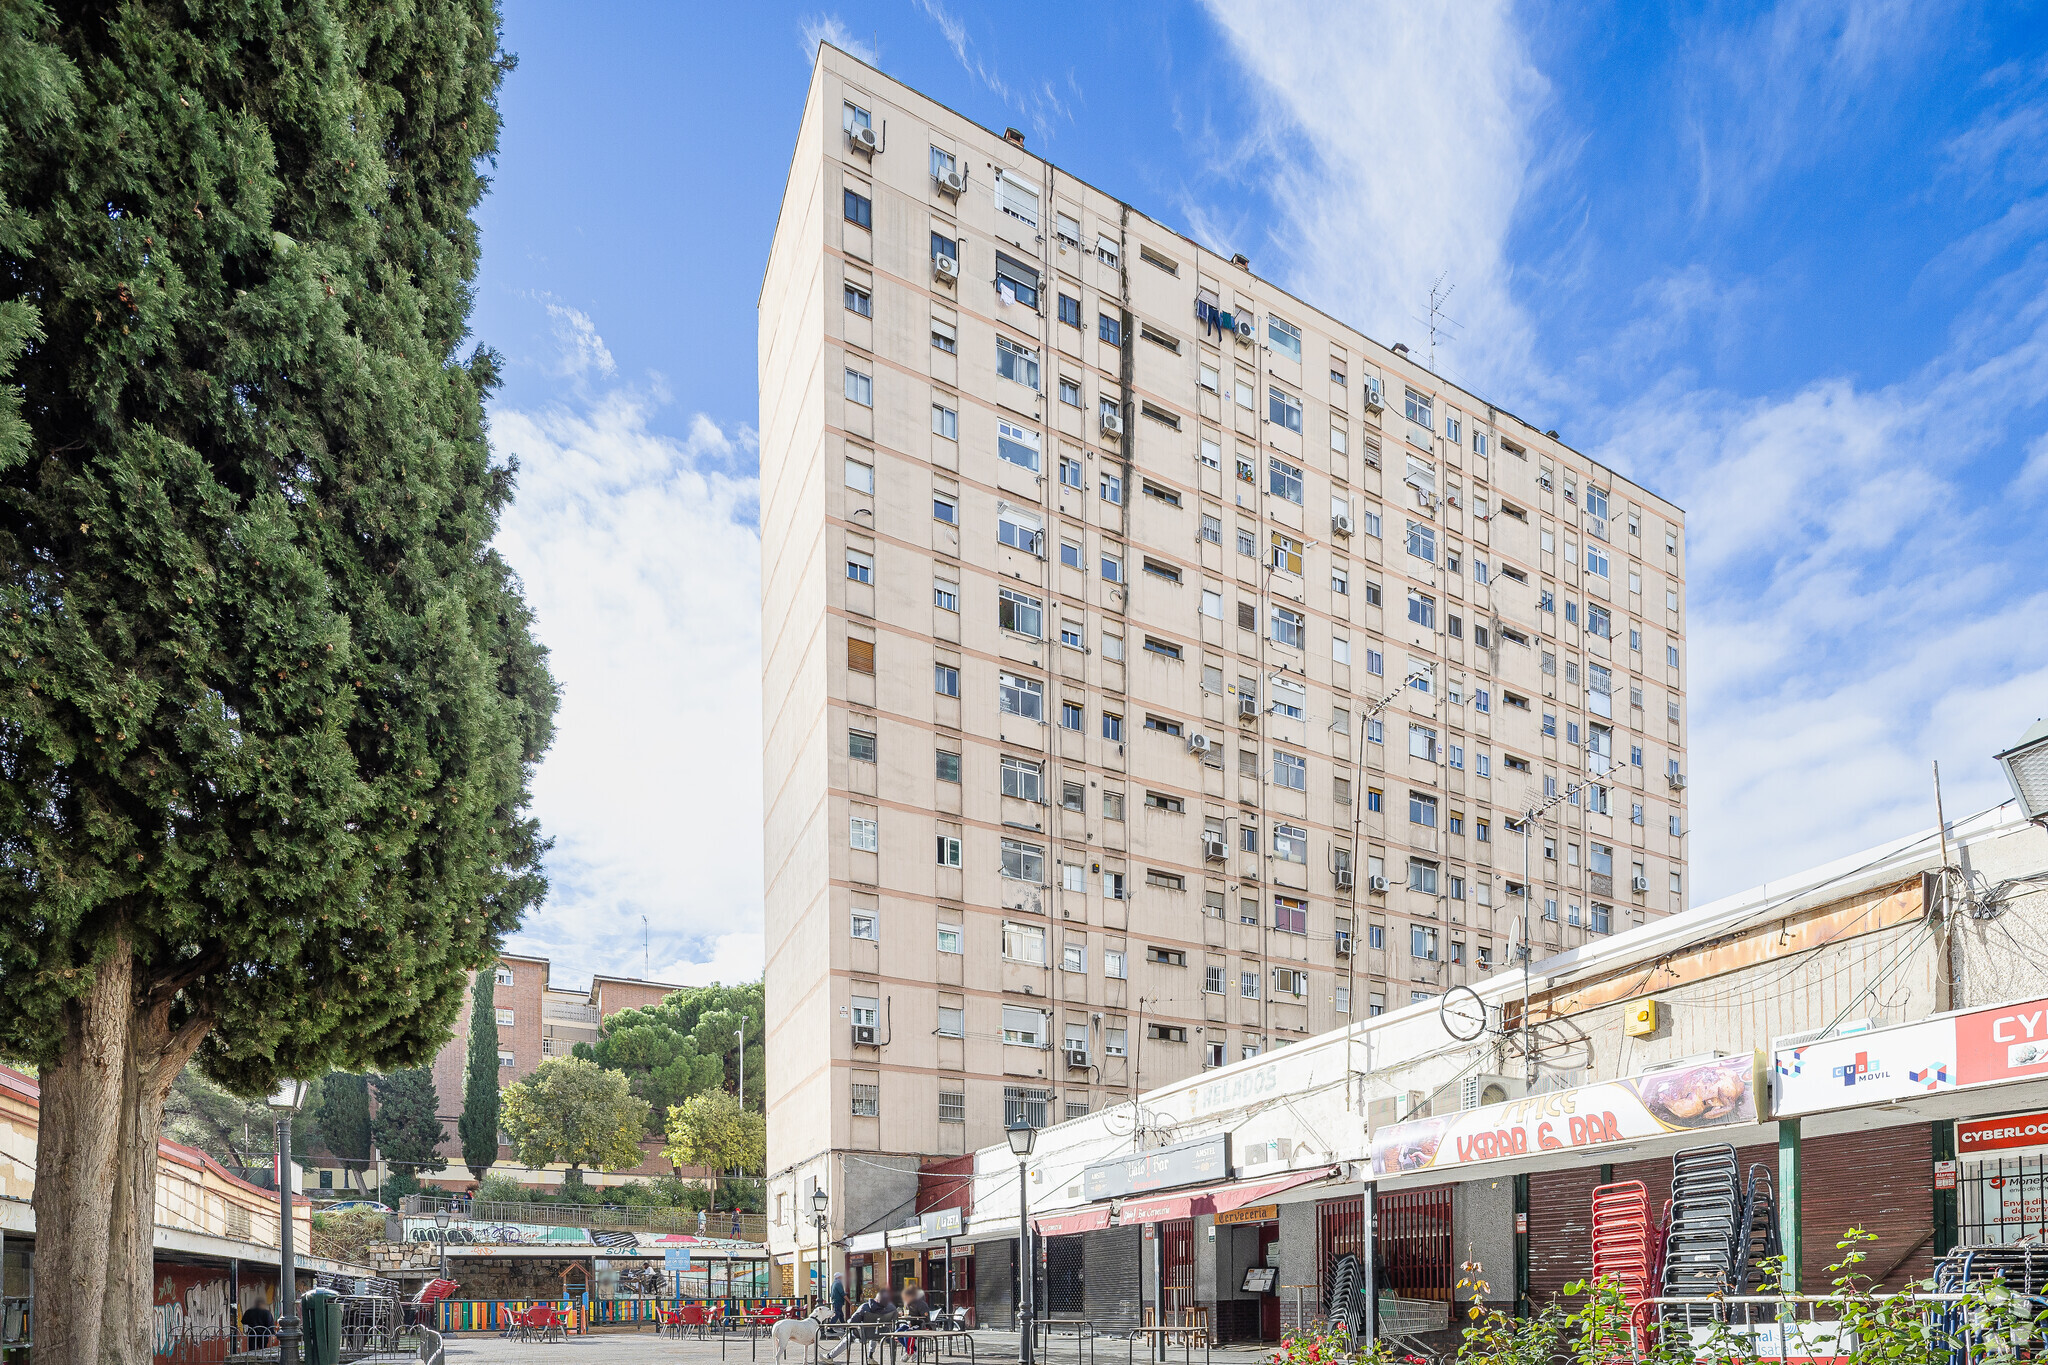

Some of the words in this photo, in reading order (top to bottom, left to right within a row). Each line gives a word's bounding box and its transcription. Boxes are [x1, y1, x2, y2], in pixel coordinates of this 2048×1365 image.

[1993, 1009, 2048, 1043] CY
[1835, 1062, 1879, 1078] CUBE
[1859, 1071, 1890, 1082] MOVIL
[1203, 1064, 1277, 1108] HELADOS
[1493, 1090, 1578, 1127] SPICE
[1456, 1126, 1528, 1163] KEBAB
[1569, 1111, 1625, 1147] BAR
[1153, 1155, 1169, 1173] Bar
[2004, 1198, 2030, 1207] Enva
